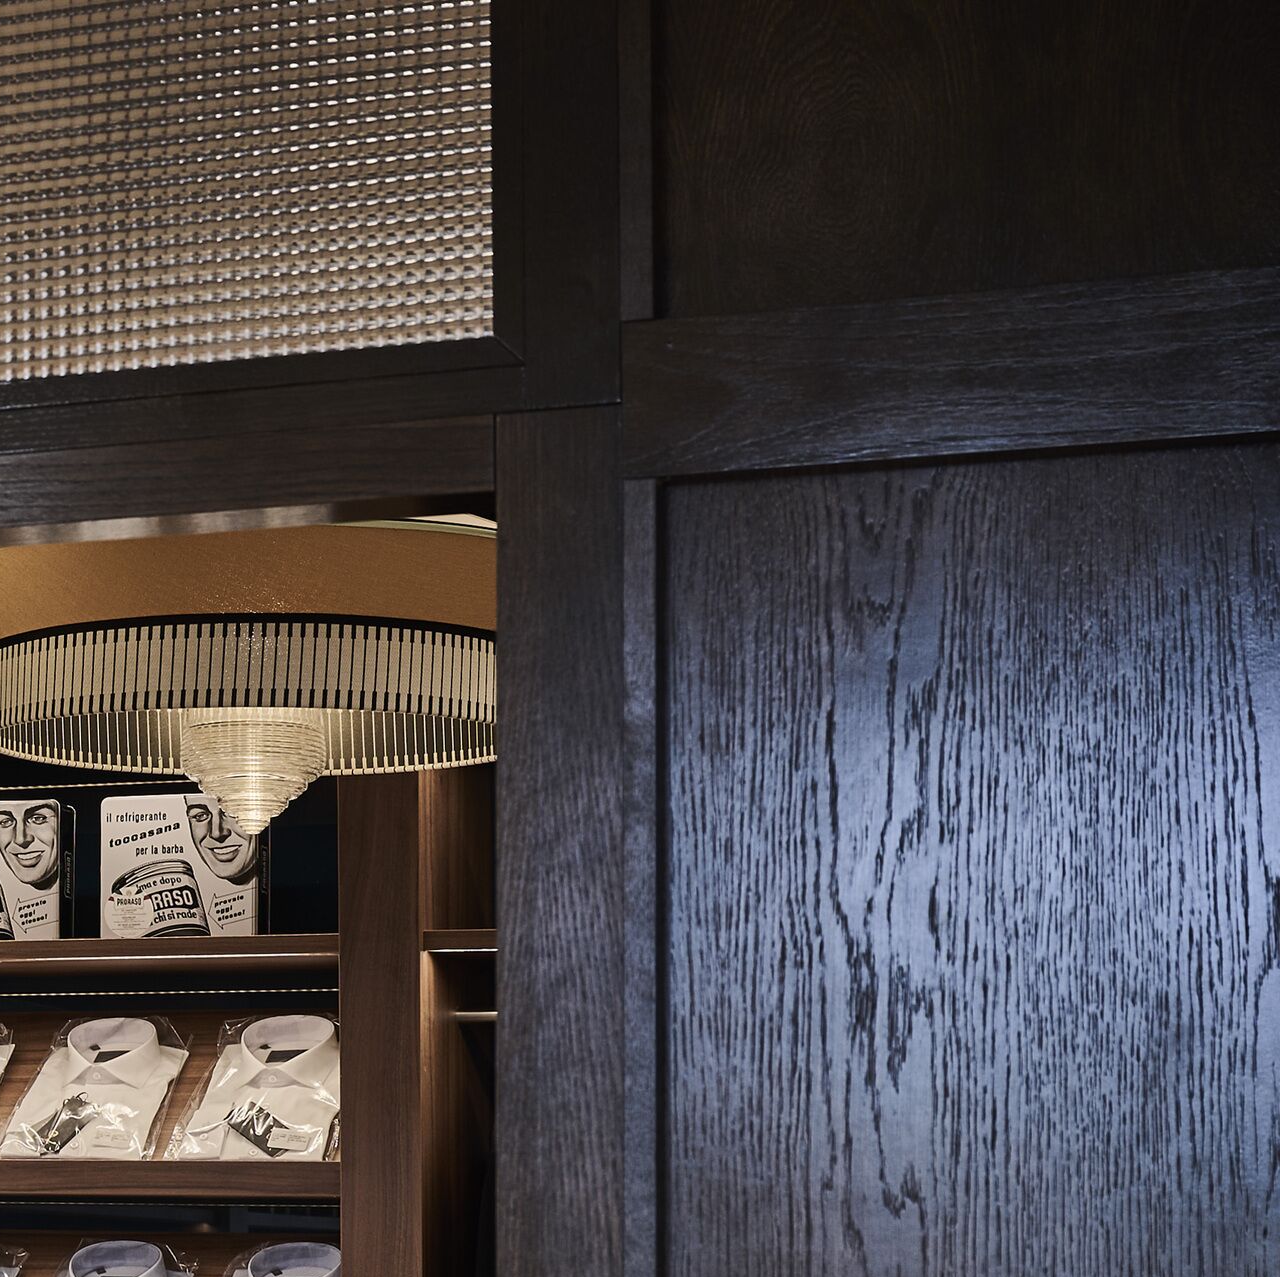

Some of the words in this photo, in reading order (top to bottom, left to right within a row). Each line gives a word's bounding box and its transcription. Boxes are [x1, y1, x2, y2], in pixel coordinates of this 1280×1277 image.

[106, 813, 112, 822] il
[116, 811, 167, 823] refrigerante
[109, 822, 181, 848] toccasana
[135, 846, 148, 857] per
[151, 845, 158, 855] la
[161, 844, 184, 854] barba
[159, 876, 182, 887] dopo
[151, 889, 194, 911] RASO
[154, 910, 167, 923] chi
[167, 909, 177, 920] si
[177, 909, 198, 920] rade
